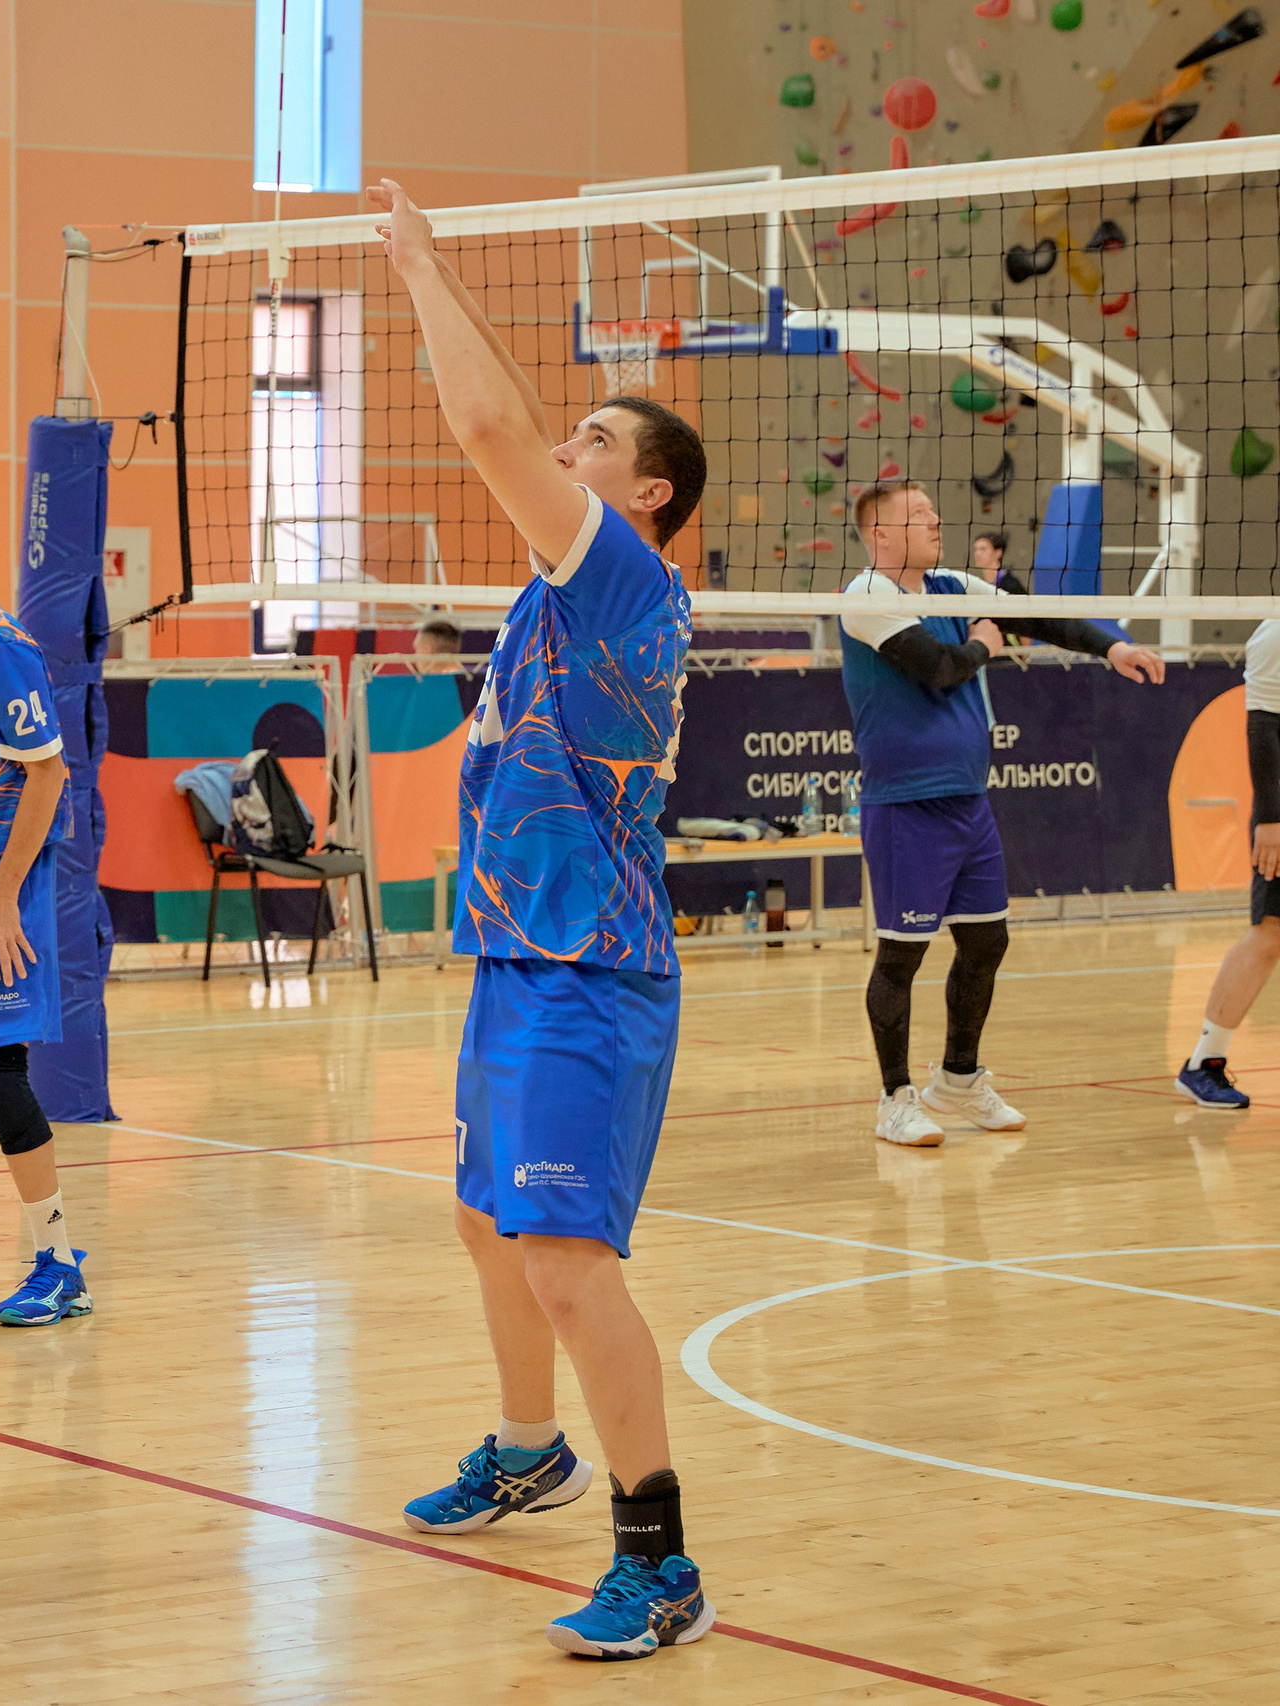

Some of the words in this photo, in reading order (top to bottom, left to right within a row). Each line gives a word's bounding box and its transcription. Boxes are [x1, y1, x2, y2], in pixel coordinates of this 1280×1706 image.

[7, 690, 48, 737] 24
[743, 729, 855, 758] СПОРТИВ
[746, 769, 863, 798] СИБИРСК
[986, 761, 1096, 789] АЛЬНОГО
[525, 1161, 575, 1173] РусГидро
[619, 1524, 662, 1533] MUELLER
